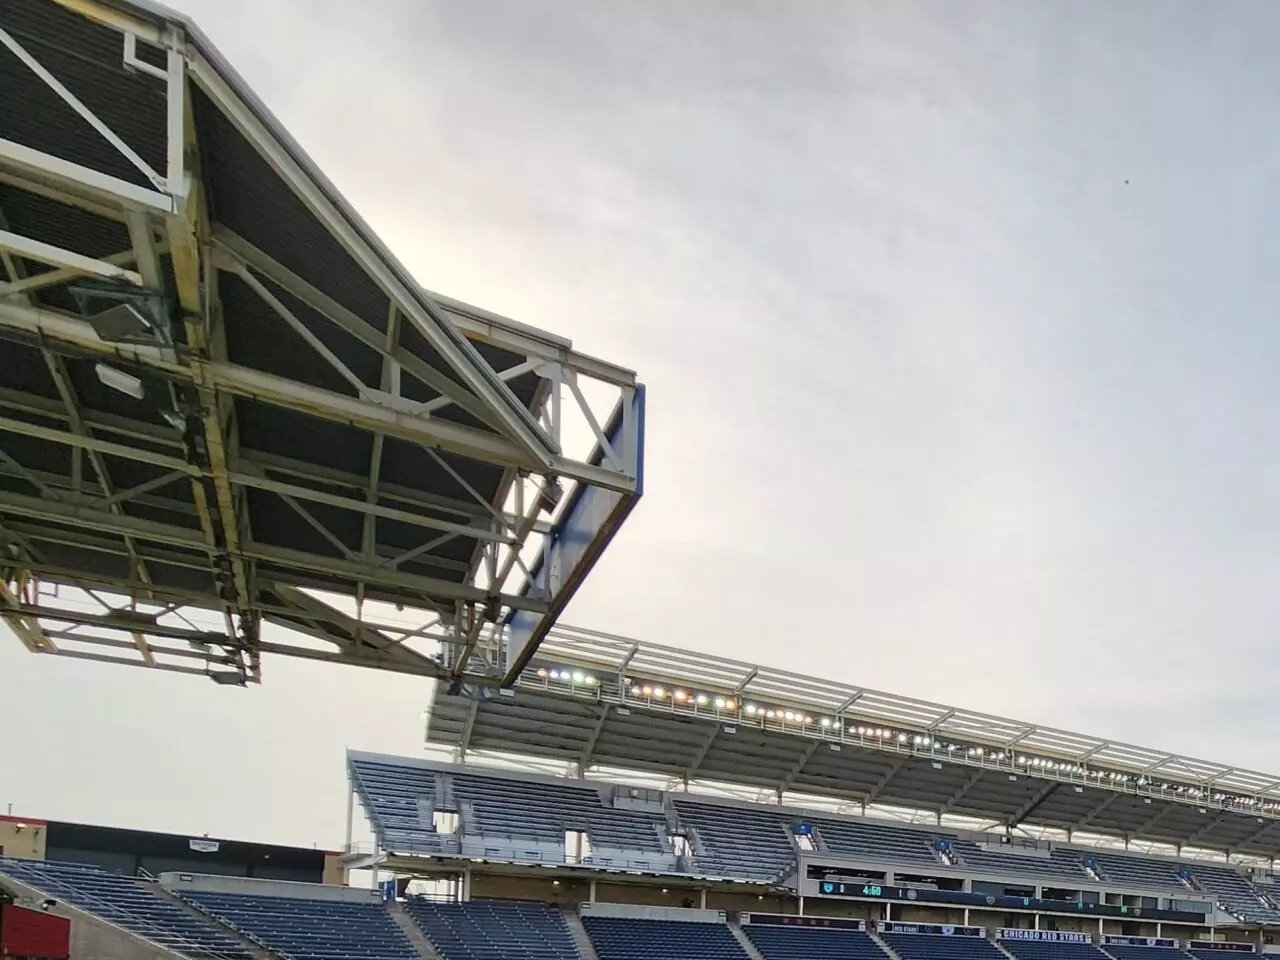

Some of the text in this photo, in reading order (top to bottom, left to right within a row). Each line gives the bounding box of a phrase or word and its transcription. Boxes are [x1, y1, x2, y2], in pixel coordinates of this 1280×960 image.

[1003, 930, 1084, 942] CHICAGO RED STARS
